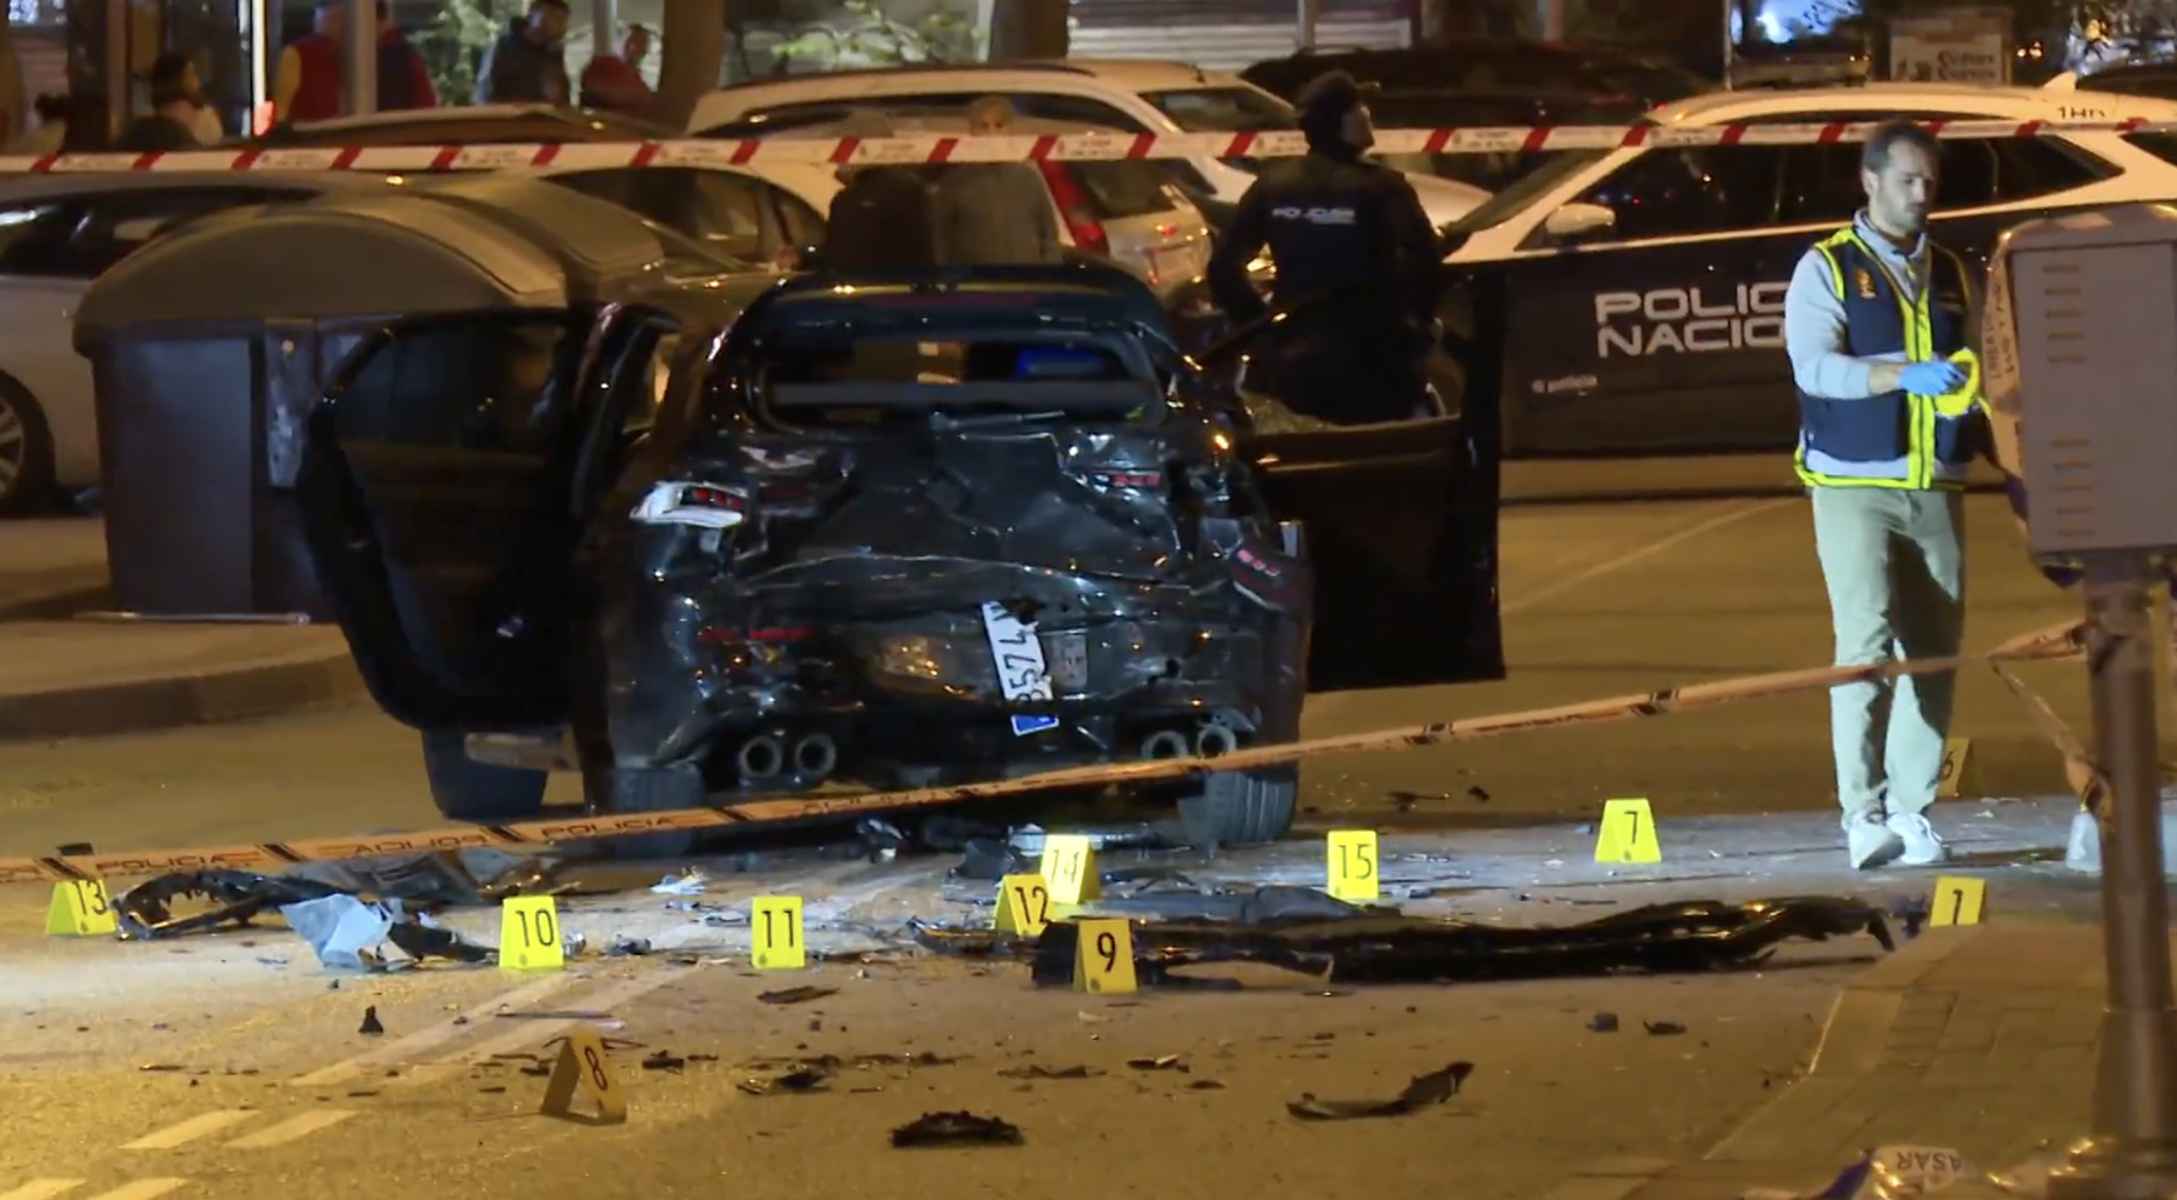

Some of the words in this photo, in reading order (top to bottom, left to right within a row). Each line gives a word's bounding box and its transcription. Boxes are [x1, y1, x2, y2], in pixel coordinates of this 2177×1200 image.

[1595, 280, 1792, 323] POLIC
[1596, 315, 1789, 358] NACIO
[1623, 810, 1638, 845] 7
[1336, 843, 1373, 880] 15
[72, 879, 109, 916] 13
[1014, 886, 1050, 926] 12
[515, 908, 555, 948] 10
[761, 908, 794, 949] 11
[1096, 931, 1117, 973] 9
[584, 1045, 608, 1091] 8
